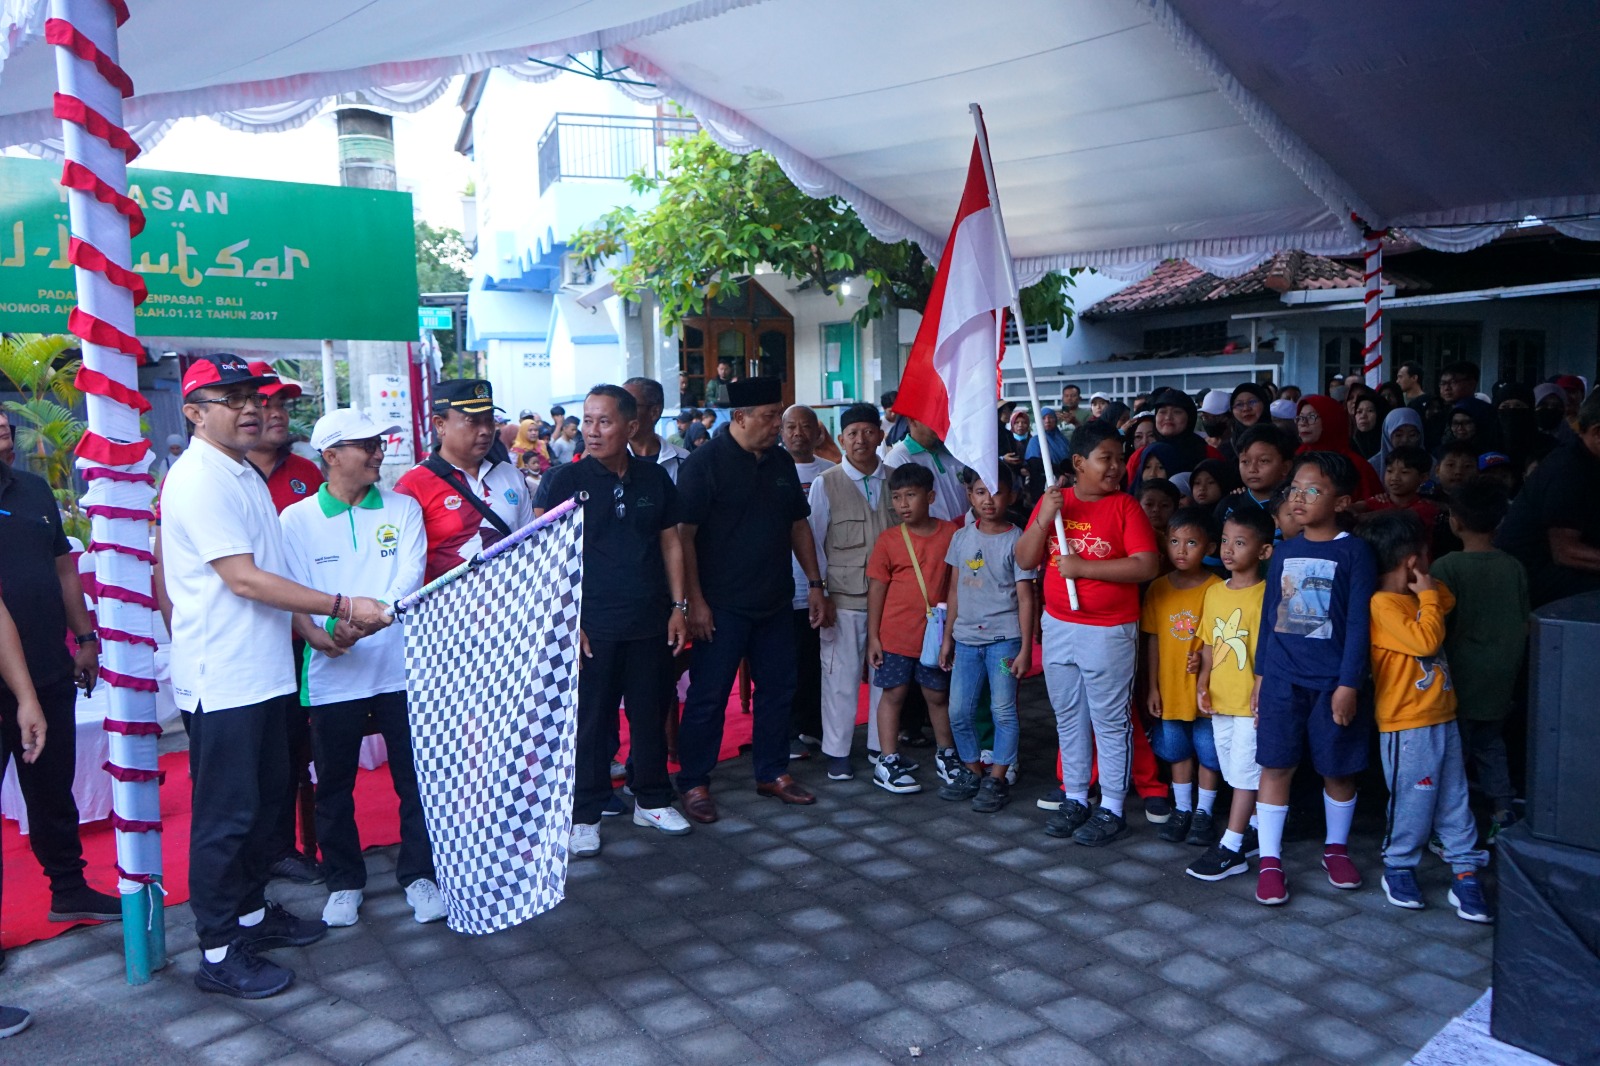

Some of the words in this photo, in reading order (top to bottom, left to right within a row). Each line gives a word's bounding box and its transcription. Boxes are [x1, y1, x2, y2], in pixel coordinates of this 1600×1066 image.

[38, 289, 78, 300] PADA
[145, 293, 204, 305] ENPASAR
[215, 296, 243, 307] BALI
[206, 309, 247, 320] TAHUN
[249, 311, 278, 321] 2017
[380, 548, 398, 558] DM
